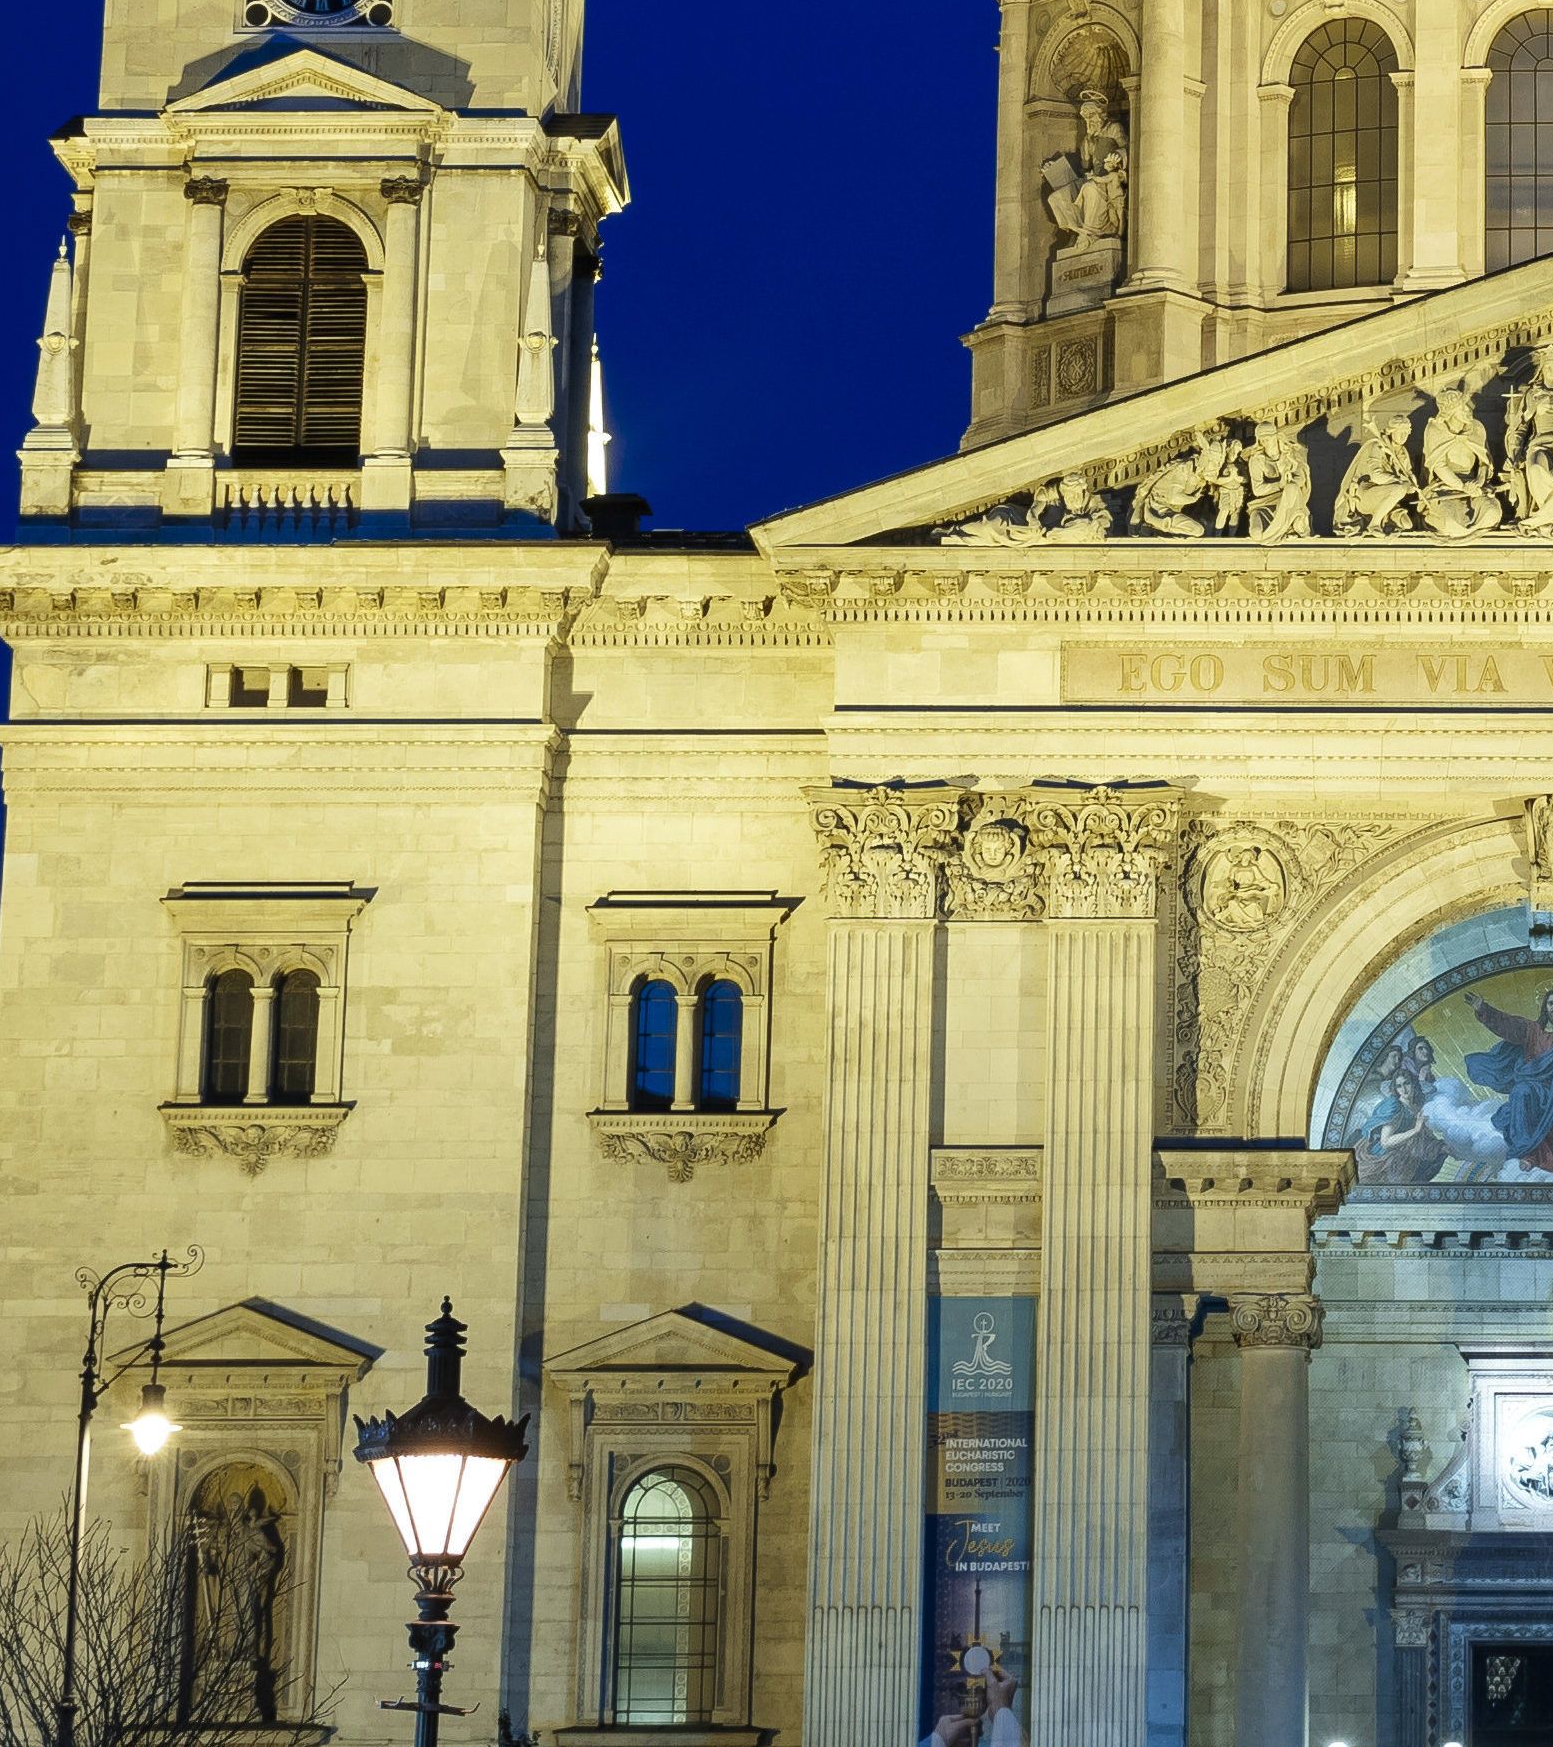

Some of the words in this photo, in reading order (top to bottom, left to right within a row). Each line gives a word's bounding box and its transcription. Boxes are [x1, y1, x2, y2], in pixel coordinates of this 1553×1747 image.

[1116, 653, 1225, 693] EGO
[1262, 653, 1378, 694] SUM
[1415, 653, 1509, 694] VIA
[952, 1378, 975, 1390] IEC
[979, 1378, 1014, 1390] 2020
[945, 1437, 1028, 1449] INTERNATIONAL
[945, 1449, 1016, 1461] EUCHARISTIC
[945, 1462, 1005, 1473] CONGRESS
[945, 1478, 998, 1488] BUDAPEST
[1005, 1476, 1032, 1487] 2020
[974, 1488, 1025, 1501] September
[971, 1522, 1001, 1533] MEET
[945, 1519, 1015, 1568] Jesus
[955, 1562, 968, 1572] IN
